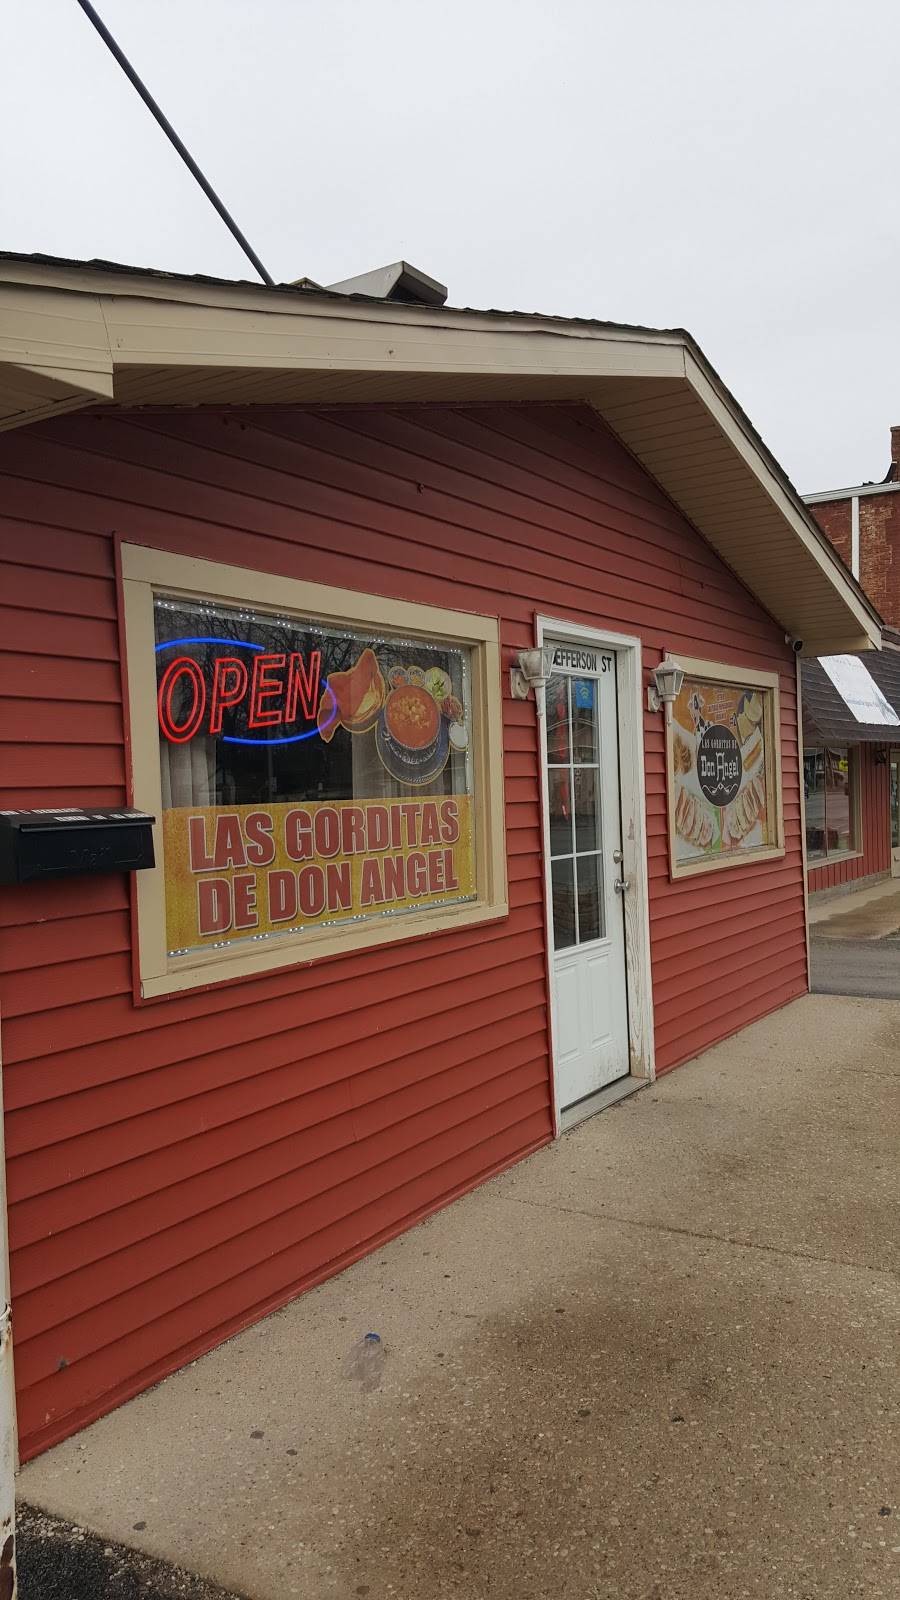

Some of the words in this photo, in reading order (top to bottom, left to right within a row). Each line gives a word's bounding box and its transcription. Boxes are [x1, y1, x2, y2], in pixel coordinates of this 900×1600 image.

[159, 651, 321, 743] OPEN
[602, 655, 612, 672] ST
[701, 755, 716, 777] Don
[716, 752, 739, 781] Angel
[189, 811, 275, 873] LAS
[285, 800, 461, 862] GORDITAS
[197, 873, 259, 936] DE
[267, 861, 353, 923] DON
[360, 848, 459, 907] ANGEL
